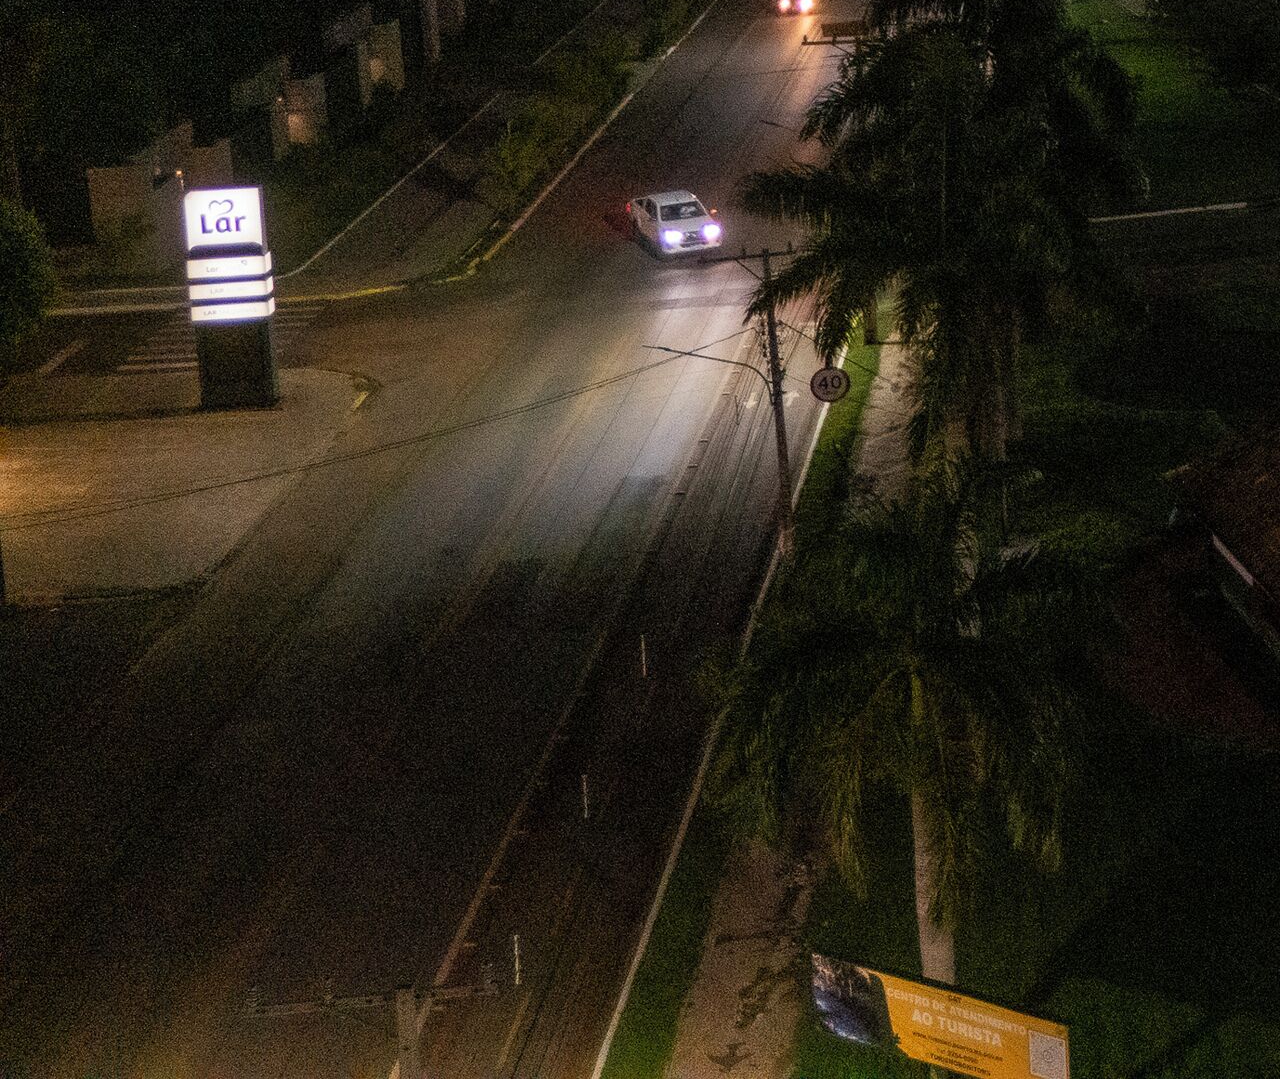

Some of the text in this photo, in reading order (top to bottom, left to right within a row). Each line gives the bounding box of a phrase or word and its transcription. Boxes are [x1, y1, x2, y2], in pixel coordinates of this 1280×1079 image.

[200, 214, 246, 234] Lar
[818, 375, 842, 390] 40
[886, 987, 1027, 1035] CENTRO DE ATENDIMENTO
[912, 1008, 1003, 1047] AO TURISTA
